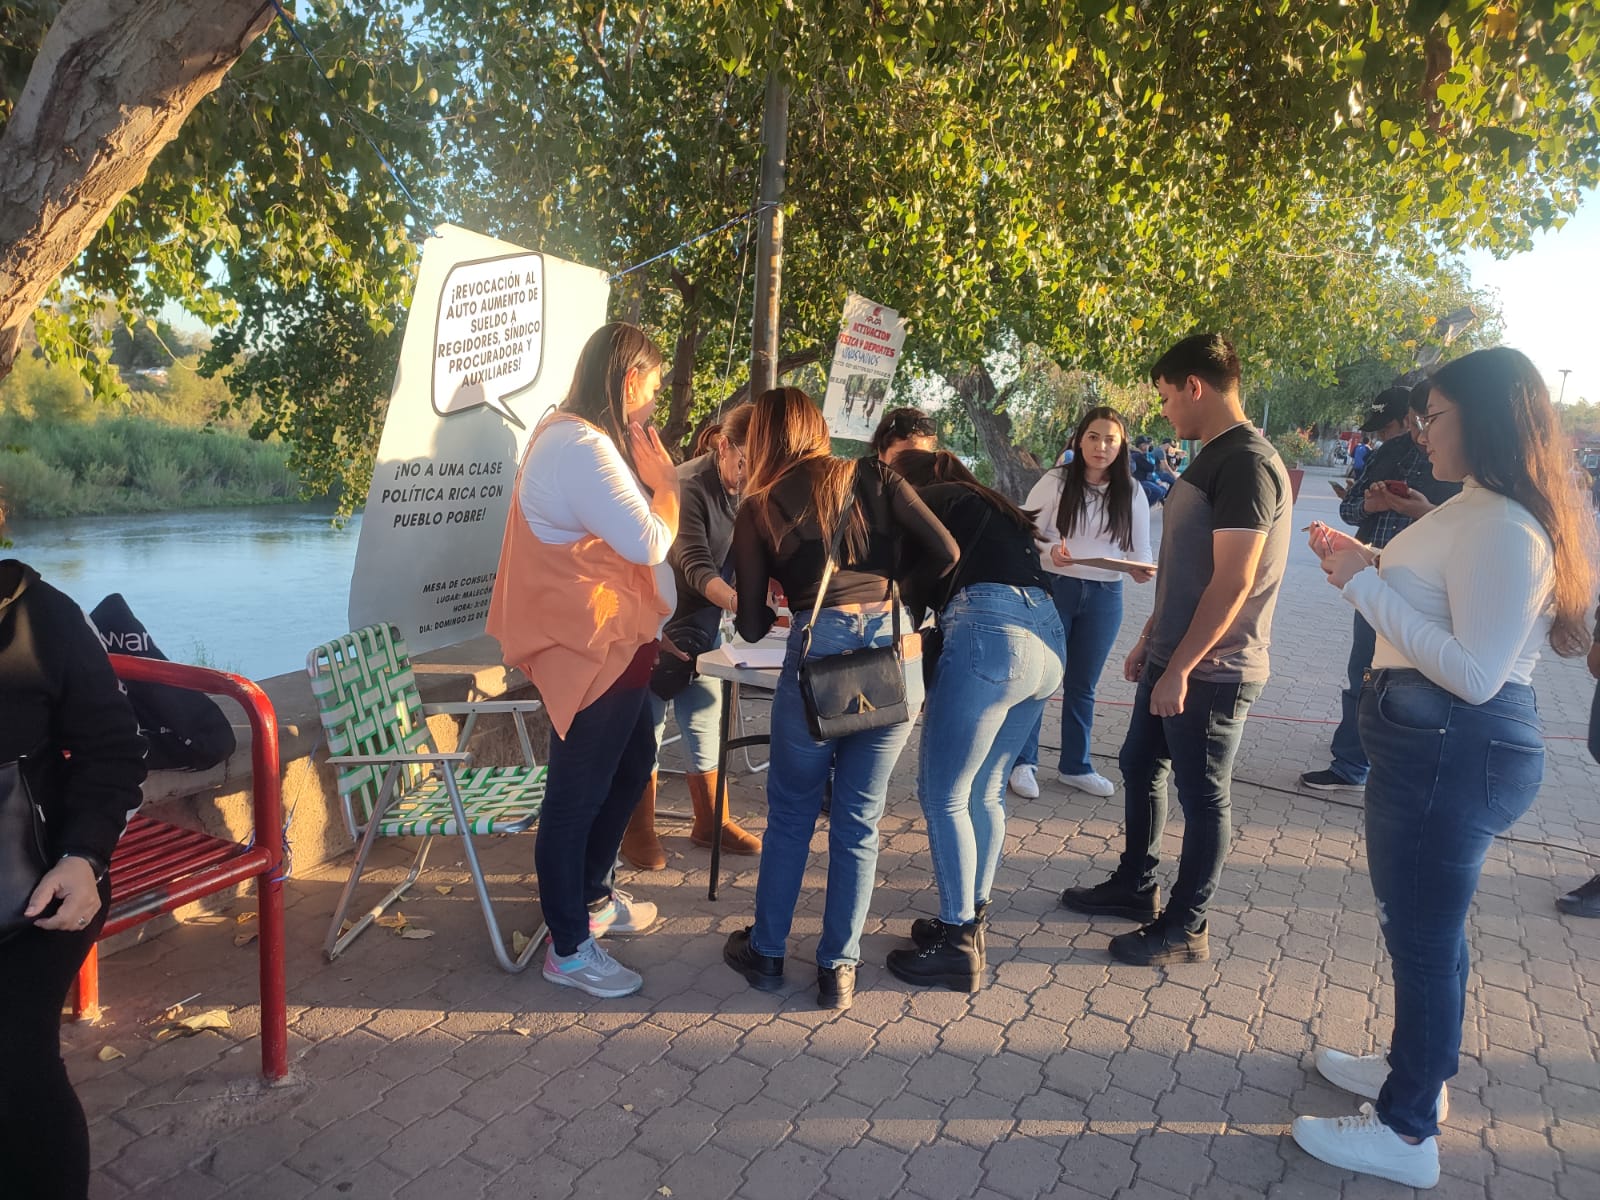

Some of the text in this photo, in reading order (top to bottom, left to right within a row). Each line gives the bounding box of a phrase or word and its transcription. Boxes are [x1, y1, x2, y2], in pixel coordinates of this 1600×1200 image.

[451, 270, 536, 304] ¡REVOCACIÓN AL
[446, 287, 538, 320] AUTO AUMENTO DE
[470, 310, 517, 333] SUELDO A
[438, 320, 540, 358] REGIDORES, SÍNDICO
[448, 338, 532, 373] PROCURADORA Y
[461, 356, 522, 388] AUXILIARES!
[394, 461, 502, 480] ¡NO A UNA CLASE
[381, 484, 503, 503] POLÍTICA RICA CON
[393, 507, 486, 528] PUEBLO POBRE!
[422, 573, 497, 594] MESA DE CONSULTA
[434, 615, 467, 630] DOMINGO
